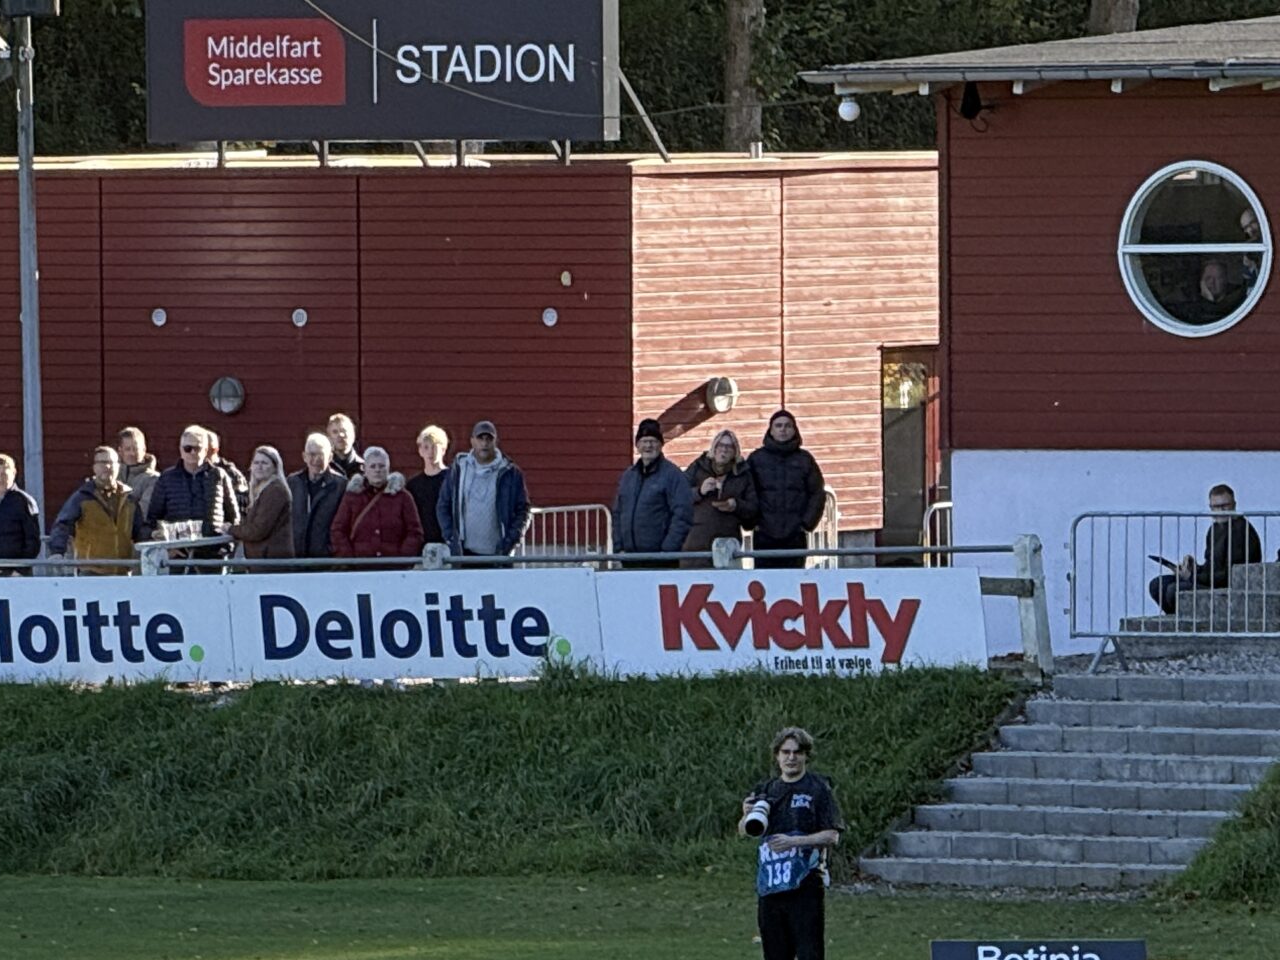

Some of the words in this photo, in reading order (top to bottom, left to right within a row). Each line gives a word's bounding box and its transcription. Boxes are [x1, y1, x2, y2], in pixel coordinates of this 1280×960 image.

[207, 35, 321, 59] Middelfart
[396, 44, 575, 83] STADION
[208, 62, 322, 90] Sparekasse
[259, 593, 571, 660] Deloitte.
[659, 580, 921, 664] Kvickly
[774, 656, 808, 670] Frihed
[811, 656, 822, 669] til
[825, 656, 836, 669] at
[838, 655, 872, 672] vælge
